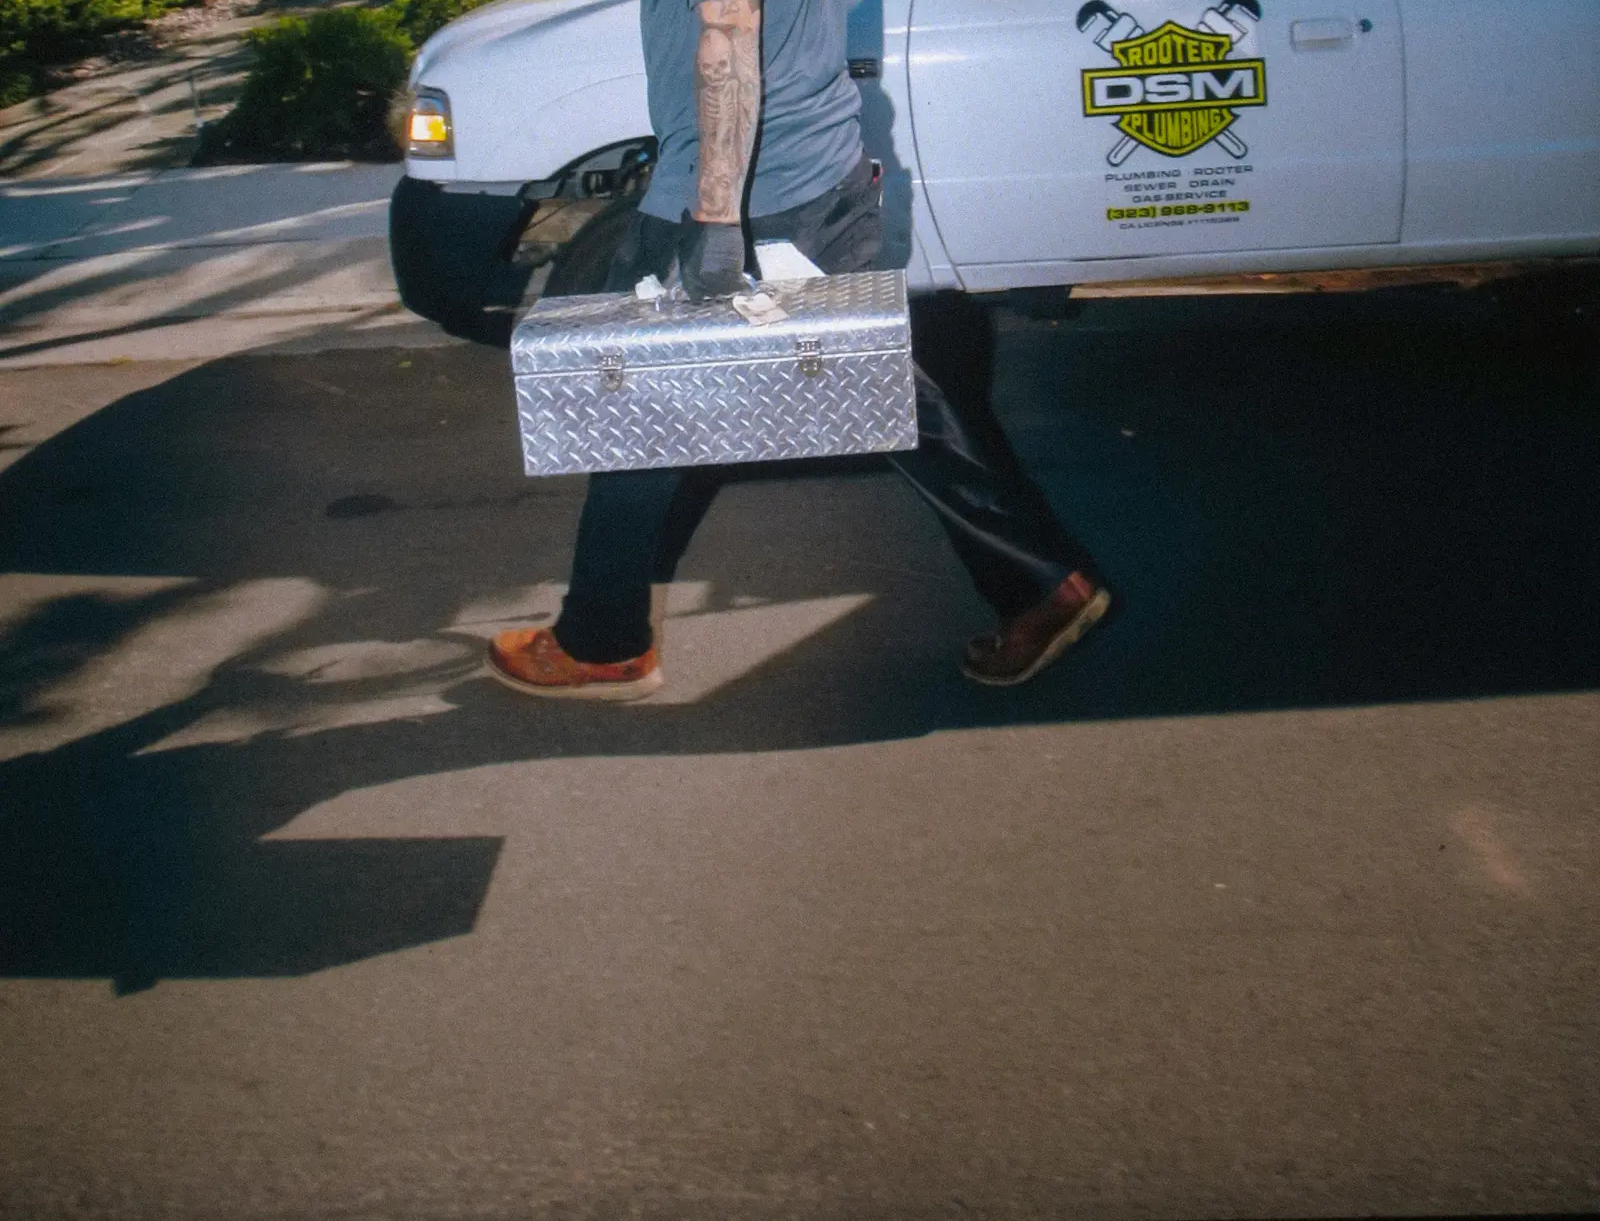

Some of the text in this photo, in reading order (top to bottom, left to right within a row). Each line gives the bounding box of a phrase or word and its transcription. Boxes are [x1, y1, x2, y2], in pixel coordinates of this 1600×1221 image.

[1127, 34, 1216, 66] ROOTER
[1093, 69, 1255, 107] DSM
[1131, 111, 1221, 148] PLUMBING
[1105, 165, 1253, 181] PLUMBING ROOTER
[1124, 179, 1235, 192] SEWER DRAIN
[1107, 206, 1156, 220] (323)
